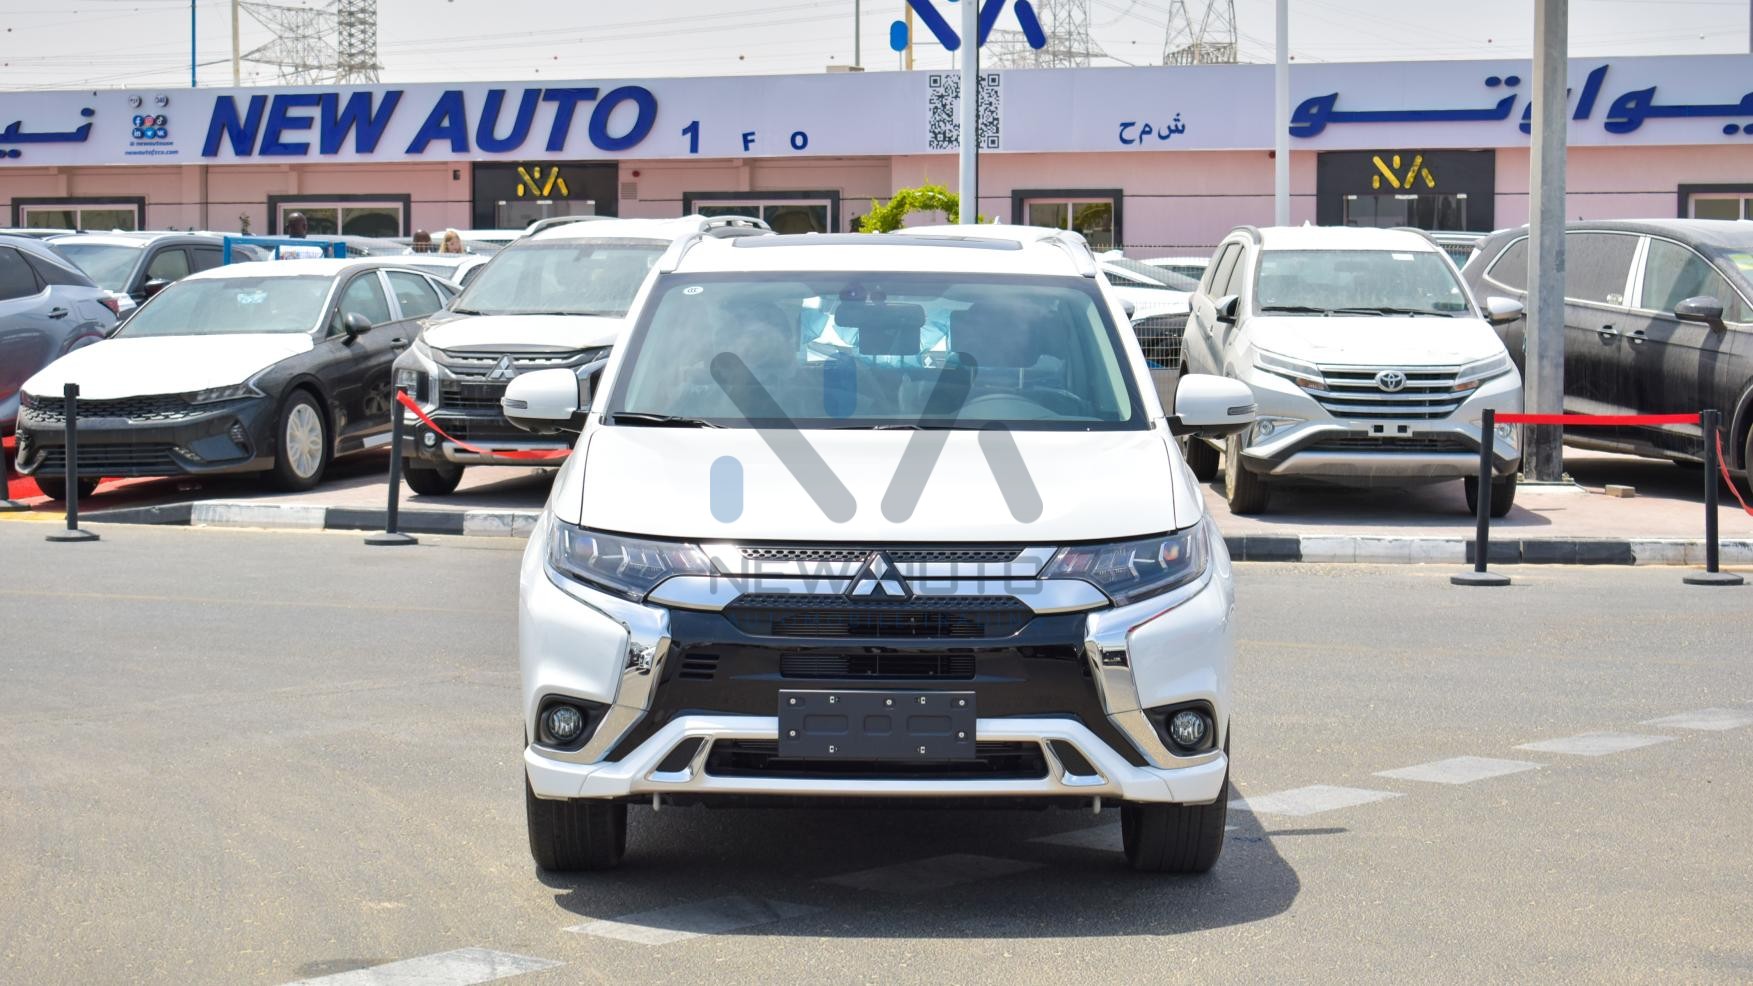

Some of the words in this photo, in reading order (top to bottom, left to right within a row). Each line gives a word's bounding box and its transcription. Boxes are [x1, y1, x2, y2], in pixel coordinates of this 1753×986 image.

[201, 90, 404, 157] NEW
[405, 85, 659, 154] AUTO
[742, 131, 756, 152] F
